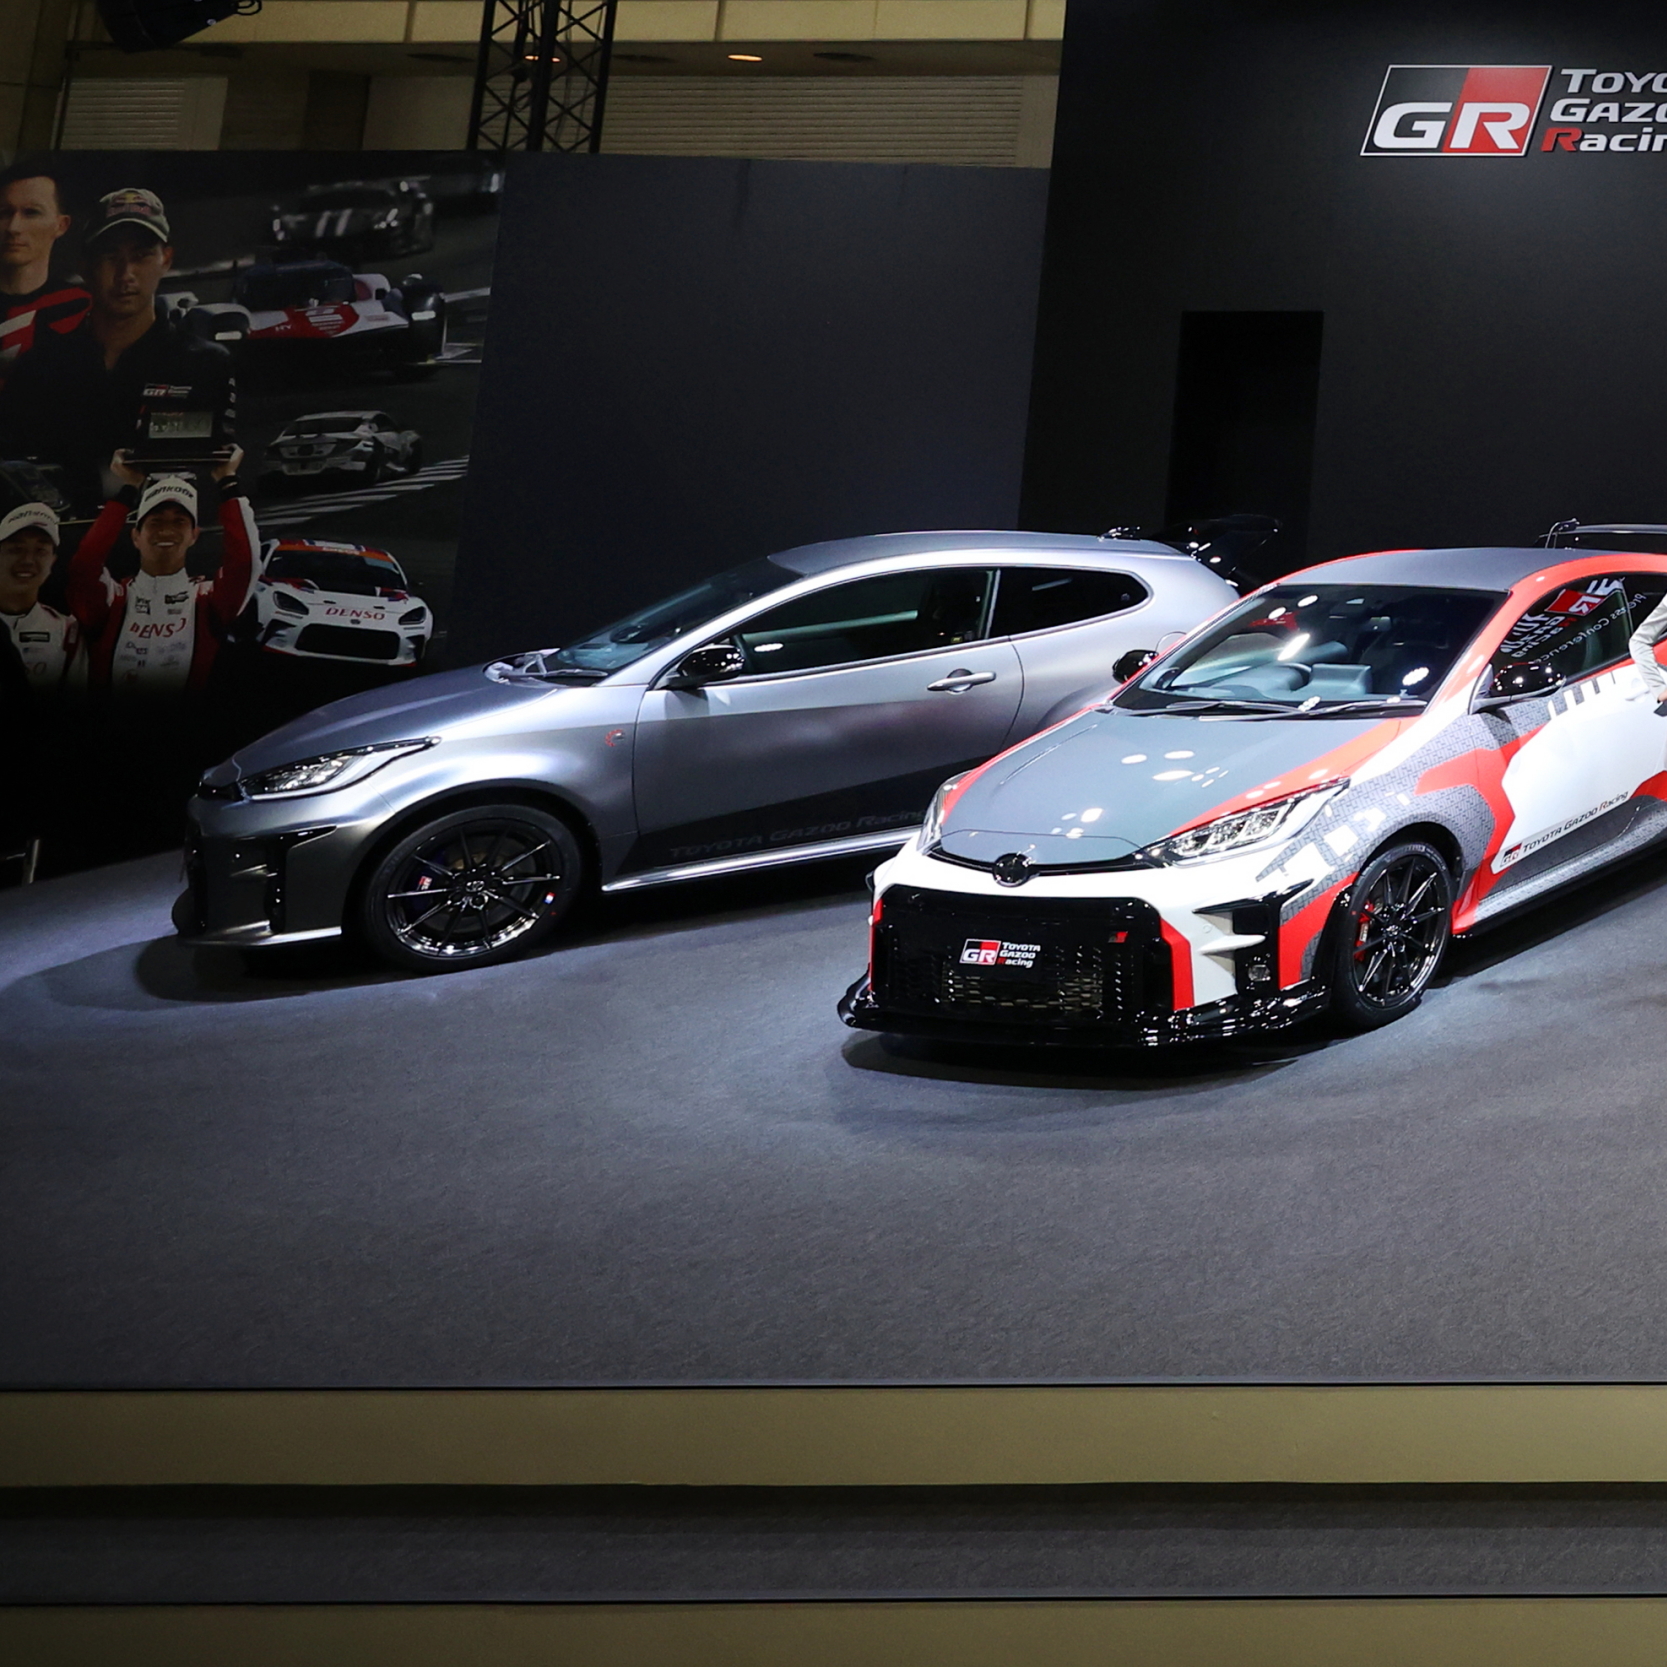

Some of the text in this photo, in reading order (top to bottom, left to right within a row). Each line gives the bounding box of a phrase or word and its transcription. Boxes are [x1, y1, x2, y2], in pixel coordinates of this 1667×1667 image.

[1372, 101, 1531, 149] GR
[325, 606, 386, 621] DENSO
[1523, 827, 1562, 853] TOYOTA
[1563, 807, 1599, 831] GAZOO
[1599, 791, 1629, 812] Racing
[669, 835, 763, 858] TOYOTA
[770, 820, 852, 842] GAZOO
[1002, 942, 1042, 952] TOYOTA
[999, 950, 1037, 960] GAZOO
[997, 957, 1034, 969] Racing
